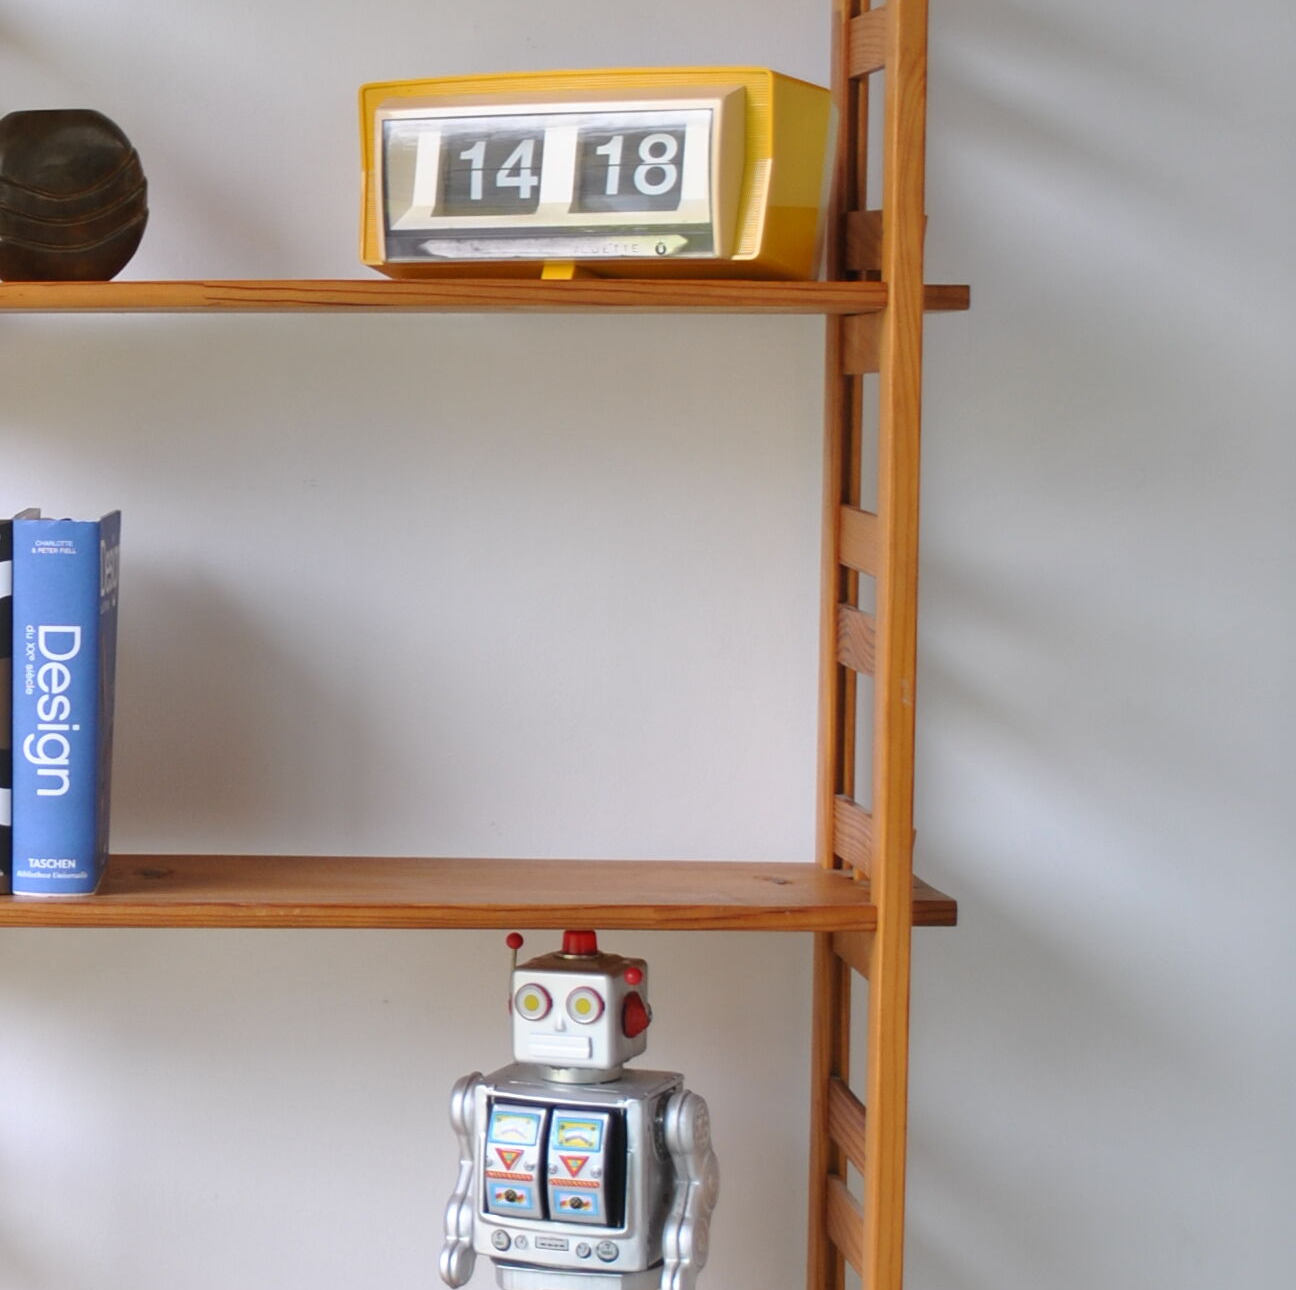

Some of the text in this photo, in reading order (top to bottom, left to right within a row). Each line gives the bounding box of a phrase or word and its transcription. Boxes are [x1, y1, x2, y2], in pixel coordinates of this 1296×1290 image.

[459, 133, 679, 200] 14 18
[25, 624, 36, 639] du
[25, 664, 36, 696] siècle
[23, 624, 81, 797] Design
[28, 858, 76, 869] TASCHEN
